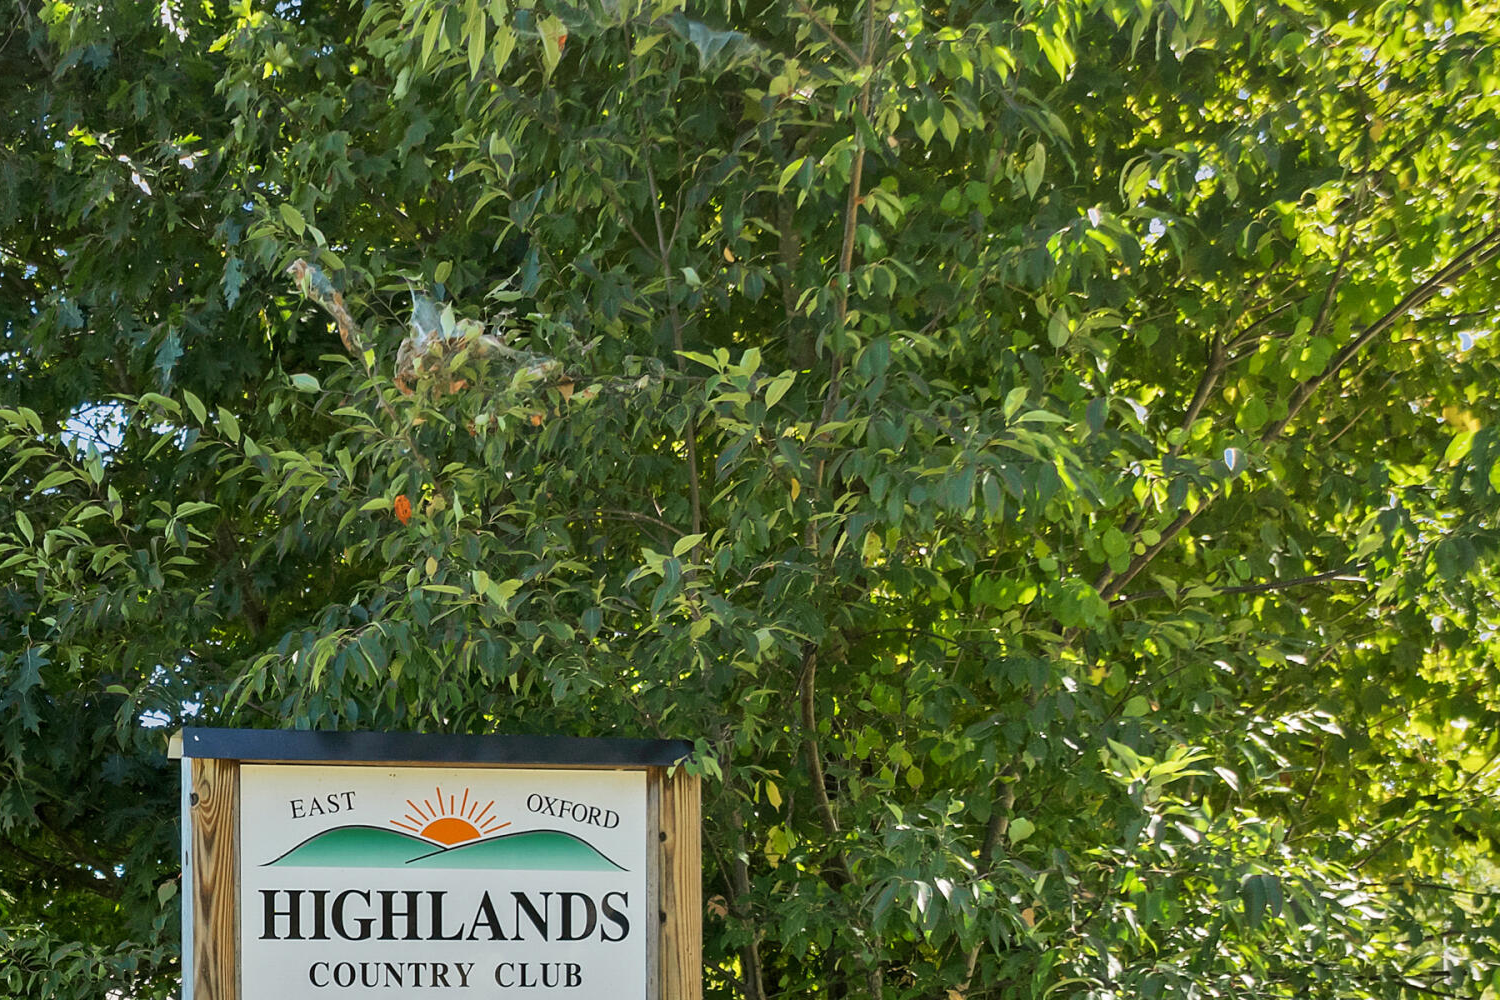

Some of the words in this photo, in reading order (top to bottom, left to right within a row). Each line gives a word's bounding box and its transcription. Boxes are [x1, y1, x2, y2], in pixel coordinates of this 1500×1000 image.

[289, 791, 356, 819] EAST
[526, 793, 620, 830] OXFORD
[258, 889, 630, 943] HIGHLANDS
[309, 961, 475, 988] COUNTRY
[494, 962, 582, 988] CLUB
